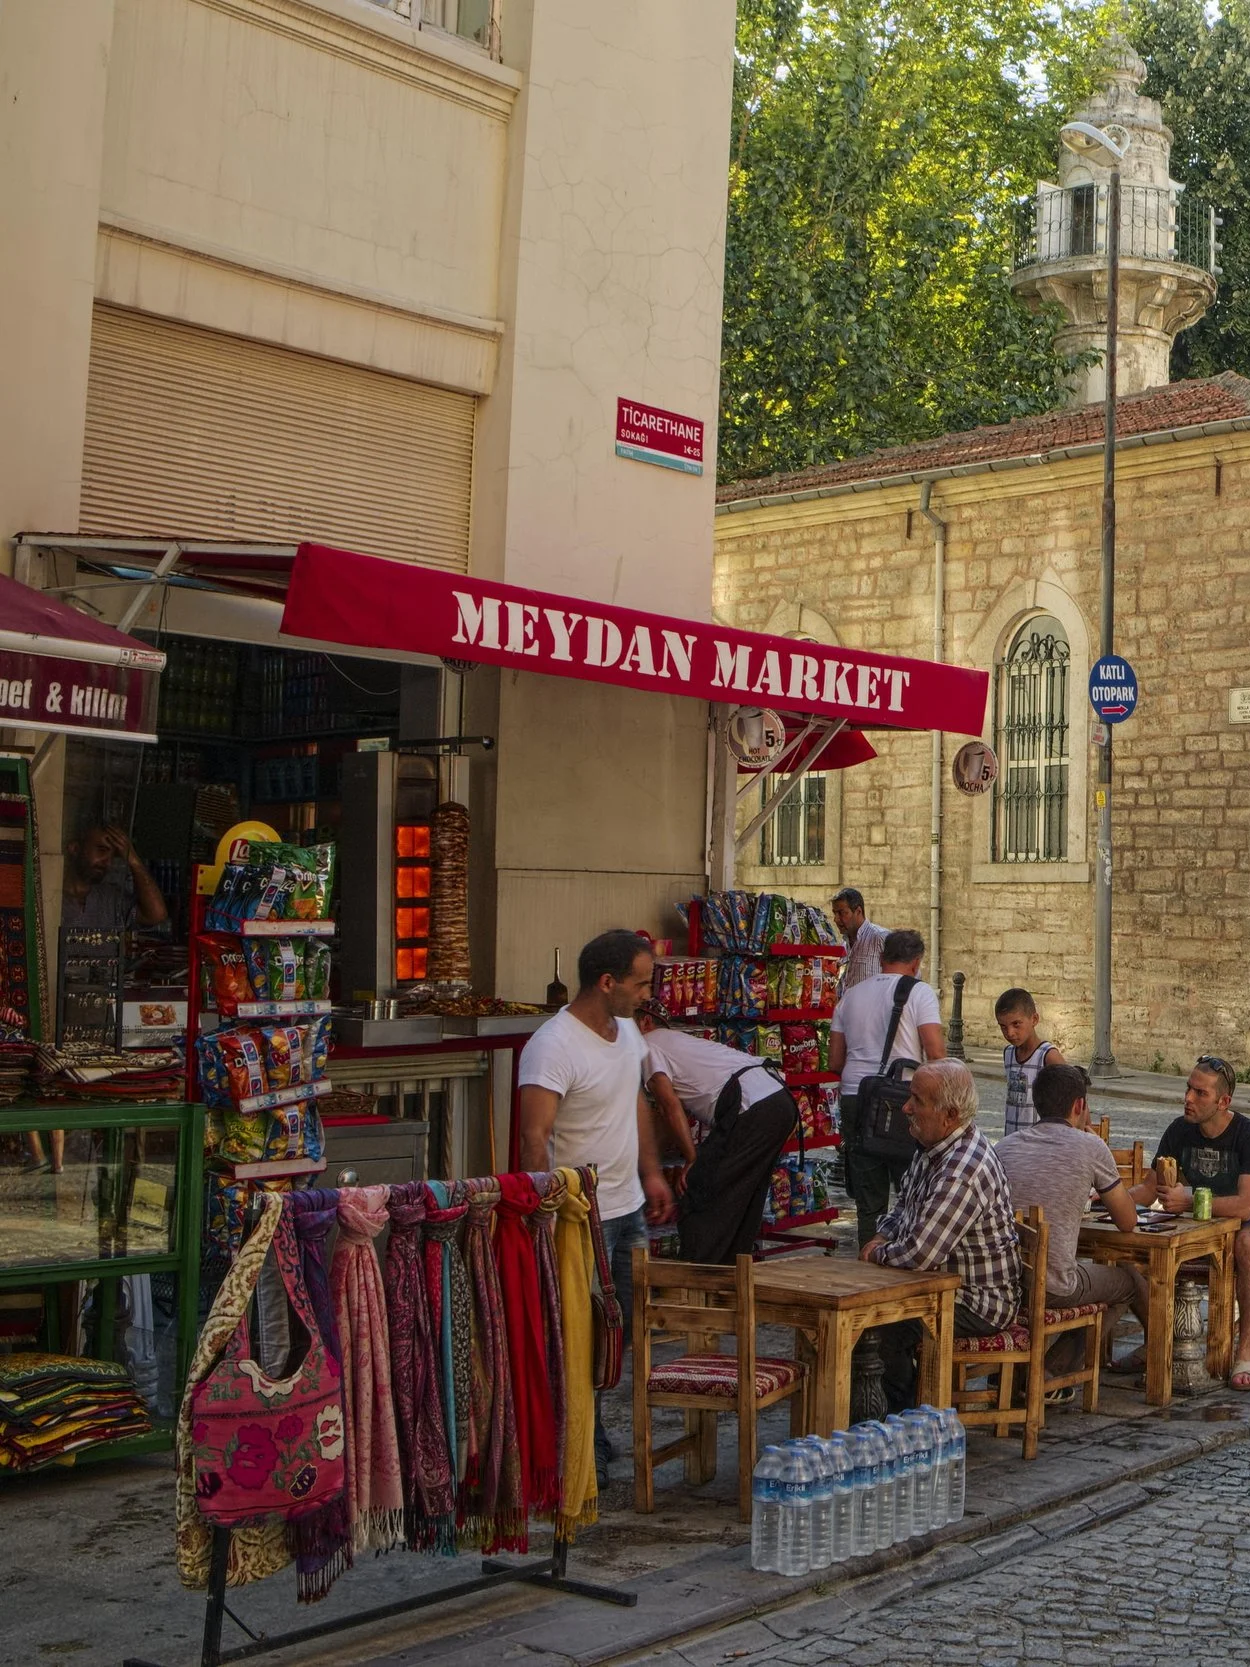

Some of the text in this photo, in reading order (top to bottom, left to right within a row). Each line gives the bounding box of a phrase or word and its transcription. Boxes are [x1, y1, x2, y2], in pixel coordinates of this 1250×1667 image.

[622, 406, 701, 443] TİCARETHANE
[621, 428, 648, 443] SOKAĞI
[452, 590, 910, 712] MEYDAN MARKET
[1100, 665, 1125, 680] KATLI
[46, 682, 63, 713] &
[70, 685, 128, 721] kilim
[1092, 686, 1135, 702] OTOPARK
[765, 730, 775, 747] 5
[982, 765, 990, 780] 5
[959, 780, 984, 793] MOCHA
